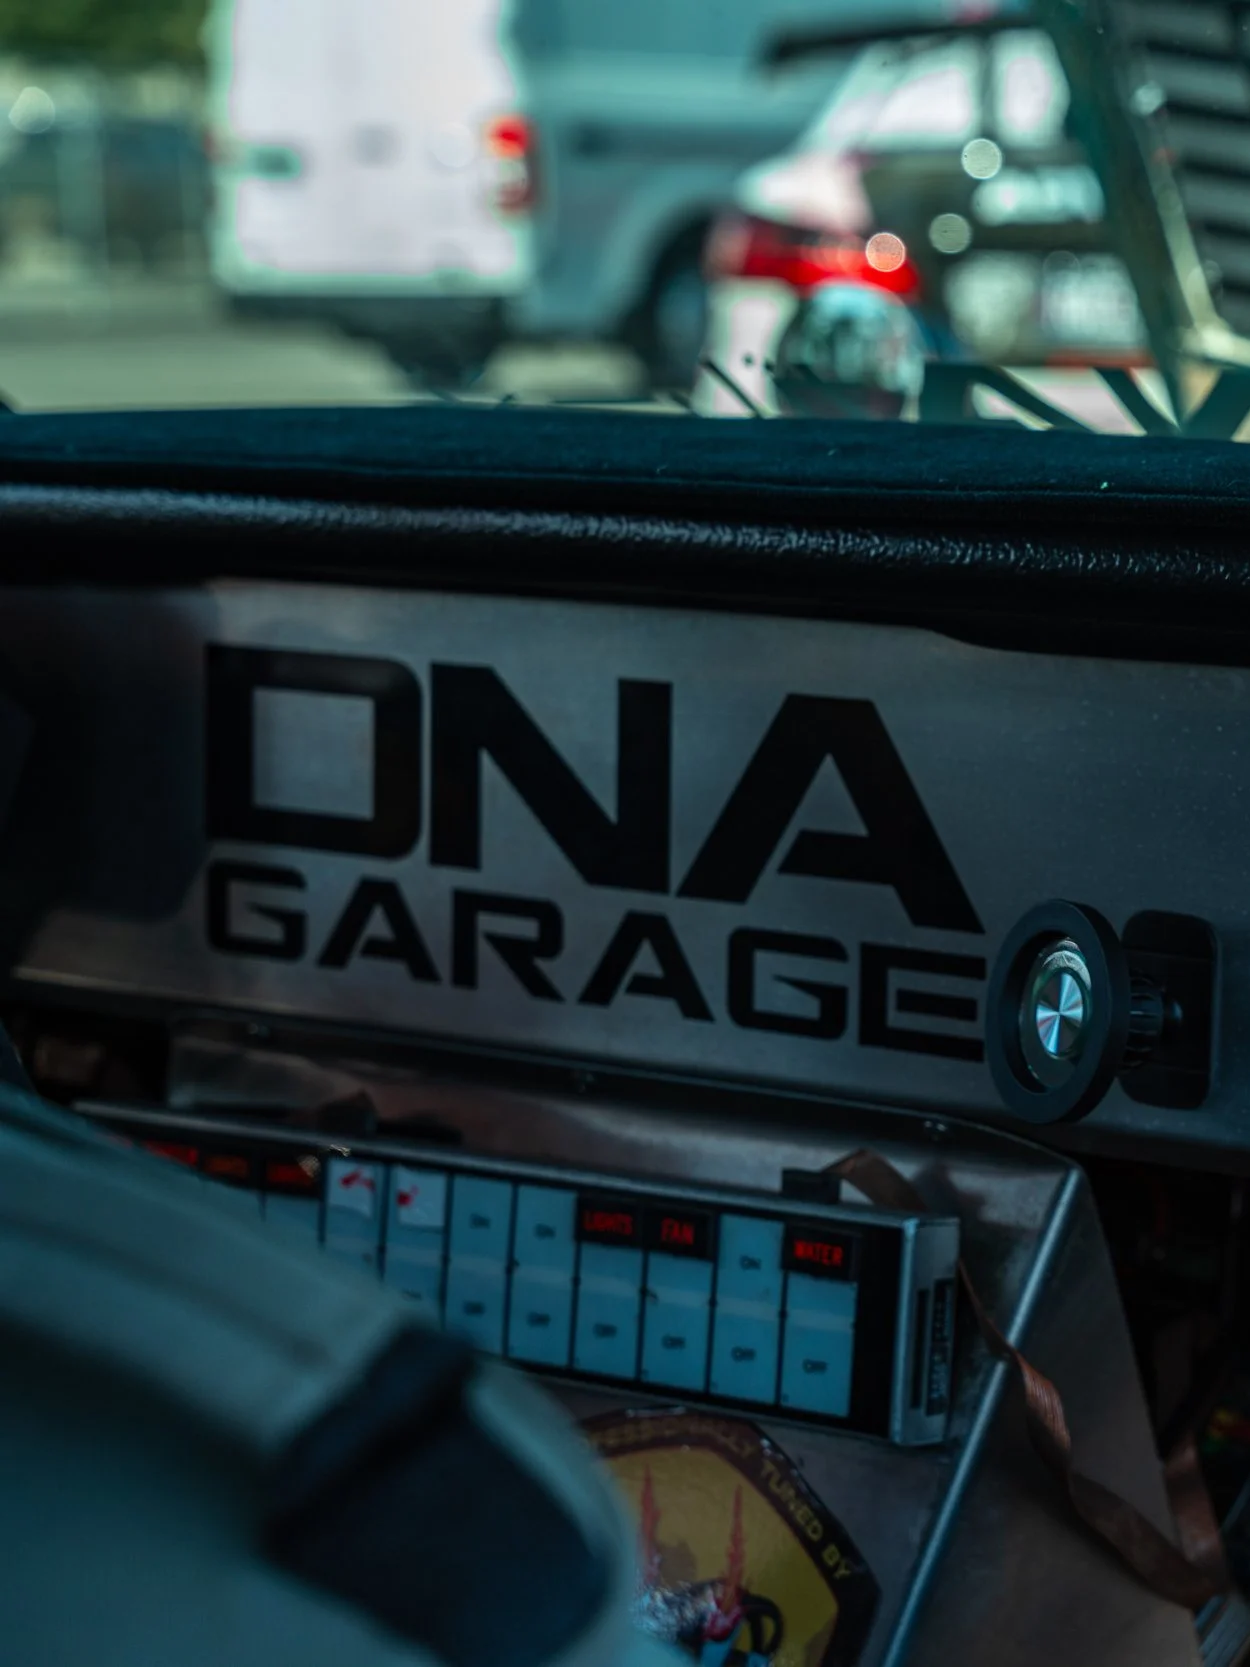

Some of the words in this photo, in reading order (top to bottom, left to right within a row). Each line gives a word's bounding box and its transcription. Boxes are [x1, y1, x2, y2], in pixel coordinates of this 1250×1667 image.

[206, 643, 987, 935] DNA
[206, 857, 987, 1064] GARAGE
[583, 1210, 634, 1236] LIGHTS
[660, 1216, 696, 1246] FAN
[793, 1237, 844, 1268] WATER
[760, 1459, 824, 1541] TUNED
[821, 1545, 852, 1581] BY
